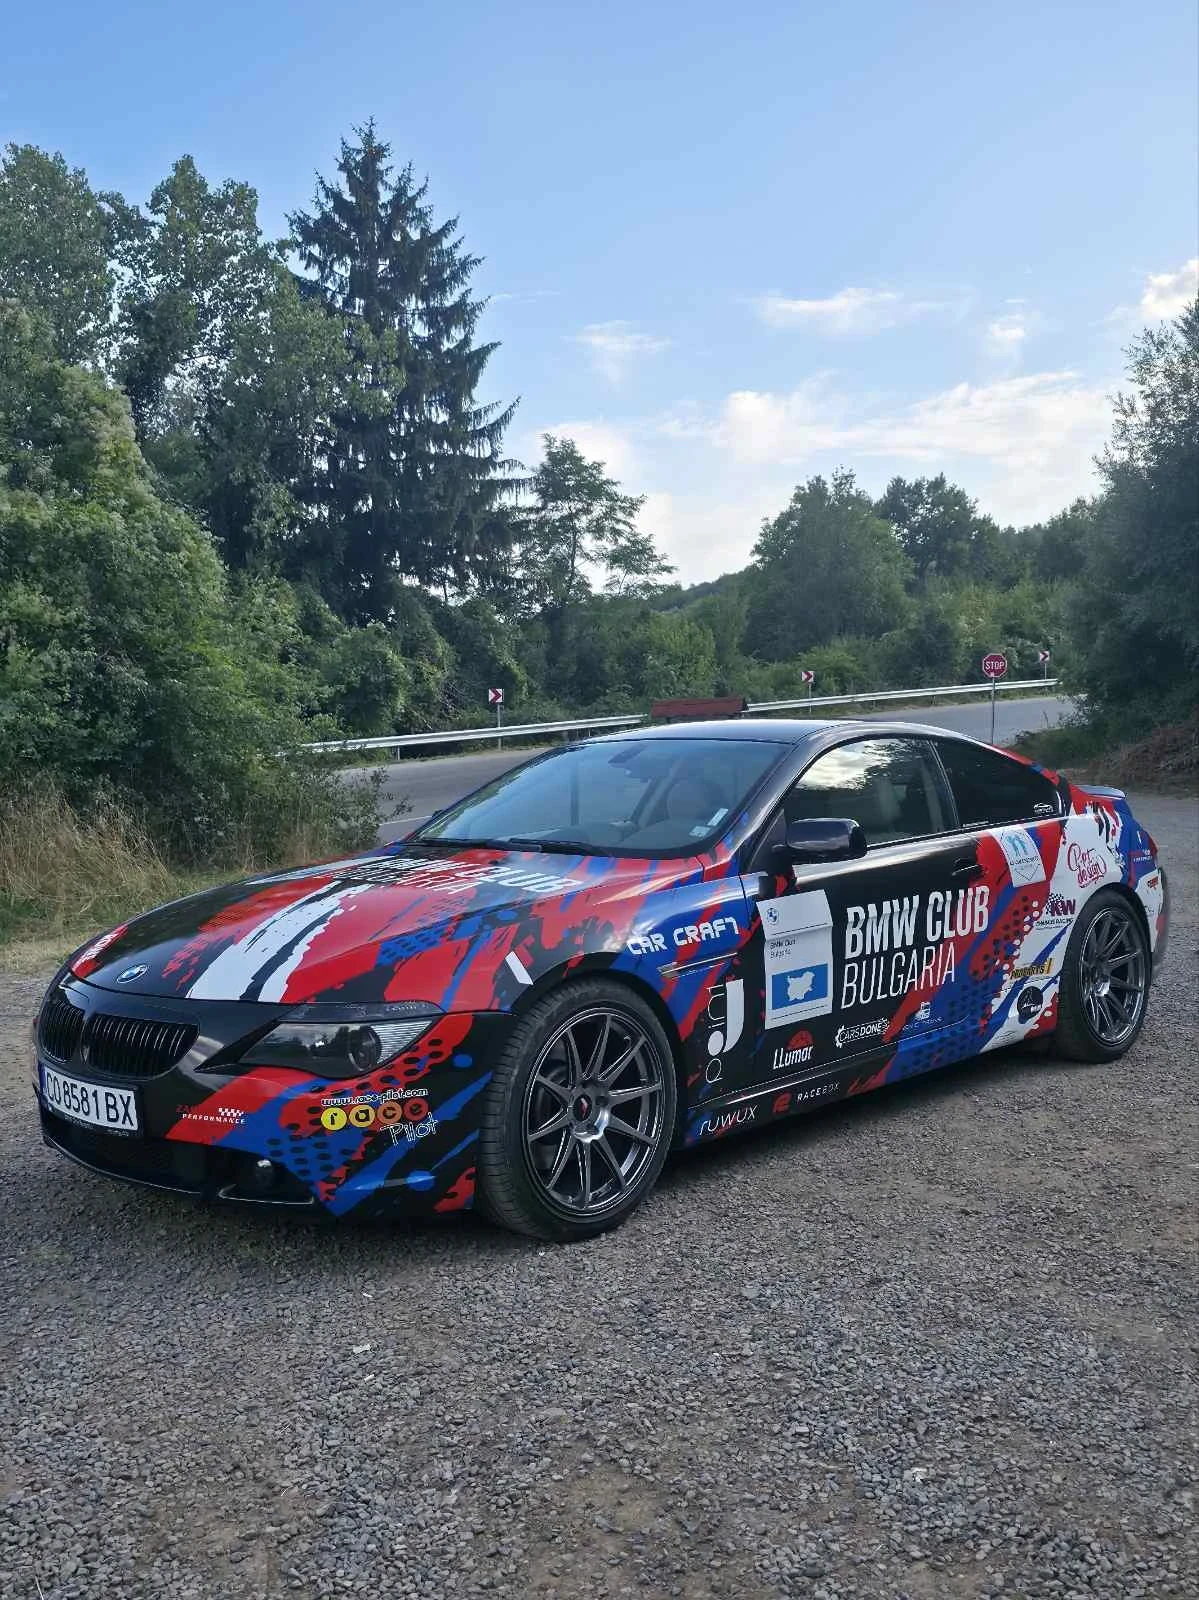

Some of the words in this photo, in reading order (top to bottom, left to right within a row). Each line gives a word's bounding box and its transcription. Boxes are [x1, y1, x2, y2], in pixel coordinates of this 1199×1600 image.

[985, 661, 1005, 670] STOP
[454, 866, 583, 893] CLUB
[626, 933, 668, 955] CAR
[673, 916, 739, 946] CRAFT
[845, 895, 920, 960] BMW
[926, 885, 990, 942] CLUB
[840, 942, 956, 1010] BULGARIA
[773, 1045, 813, 1070] LLumar
[62, 1080, 100, 1121] 8581
[104, 1091, 135, 1127] BX
[320, 1088, 428, 1106] www.race-pilot.com
[796, 1081, 840, 1104] RACEBOX
[181, 1113, 246, 1125] PERFORMANCE
[379, 1111, 438, 1146] Pilot
